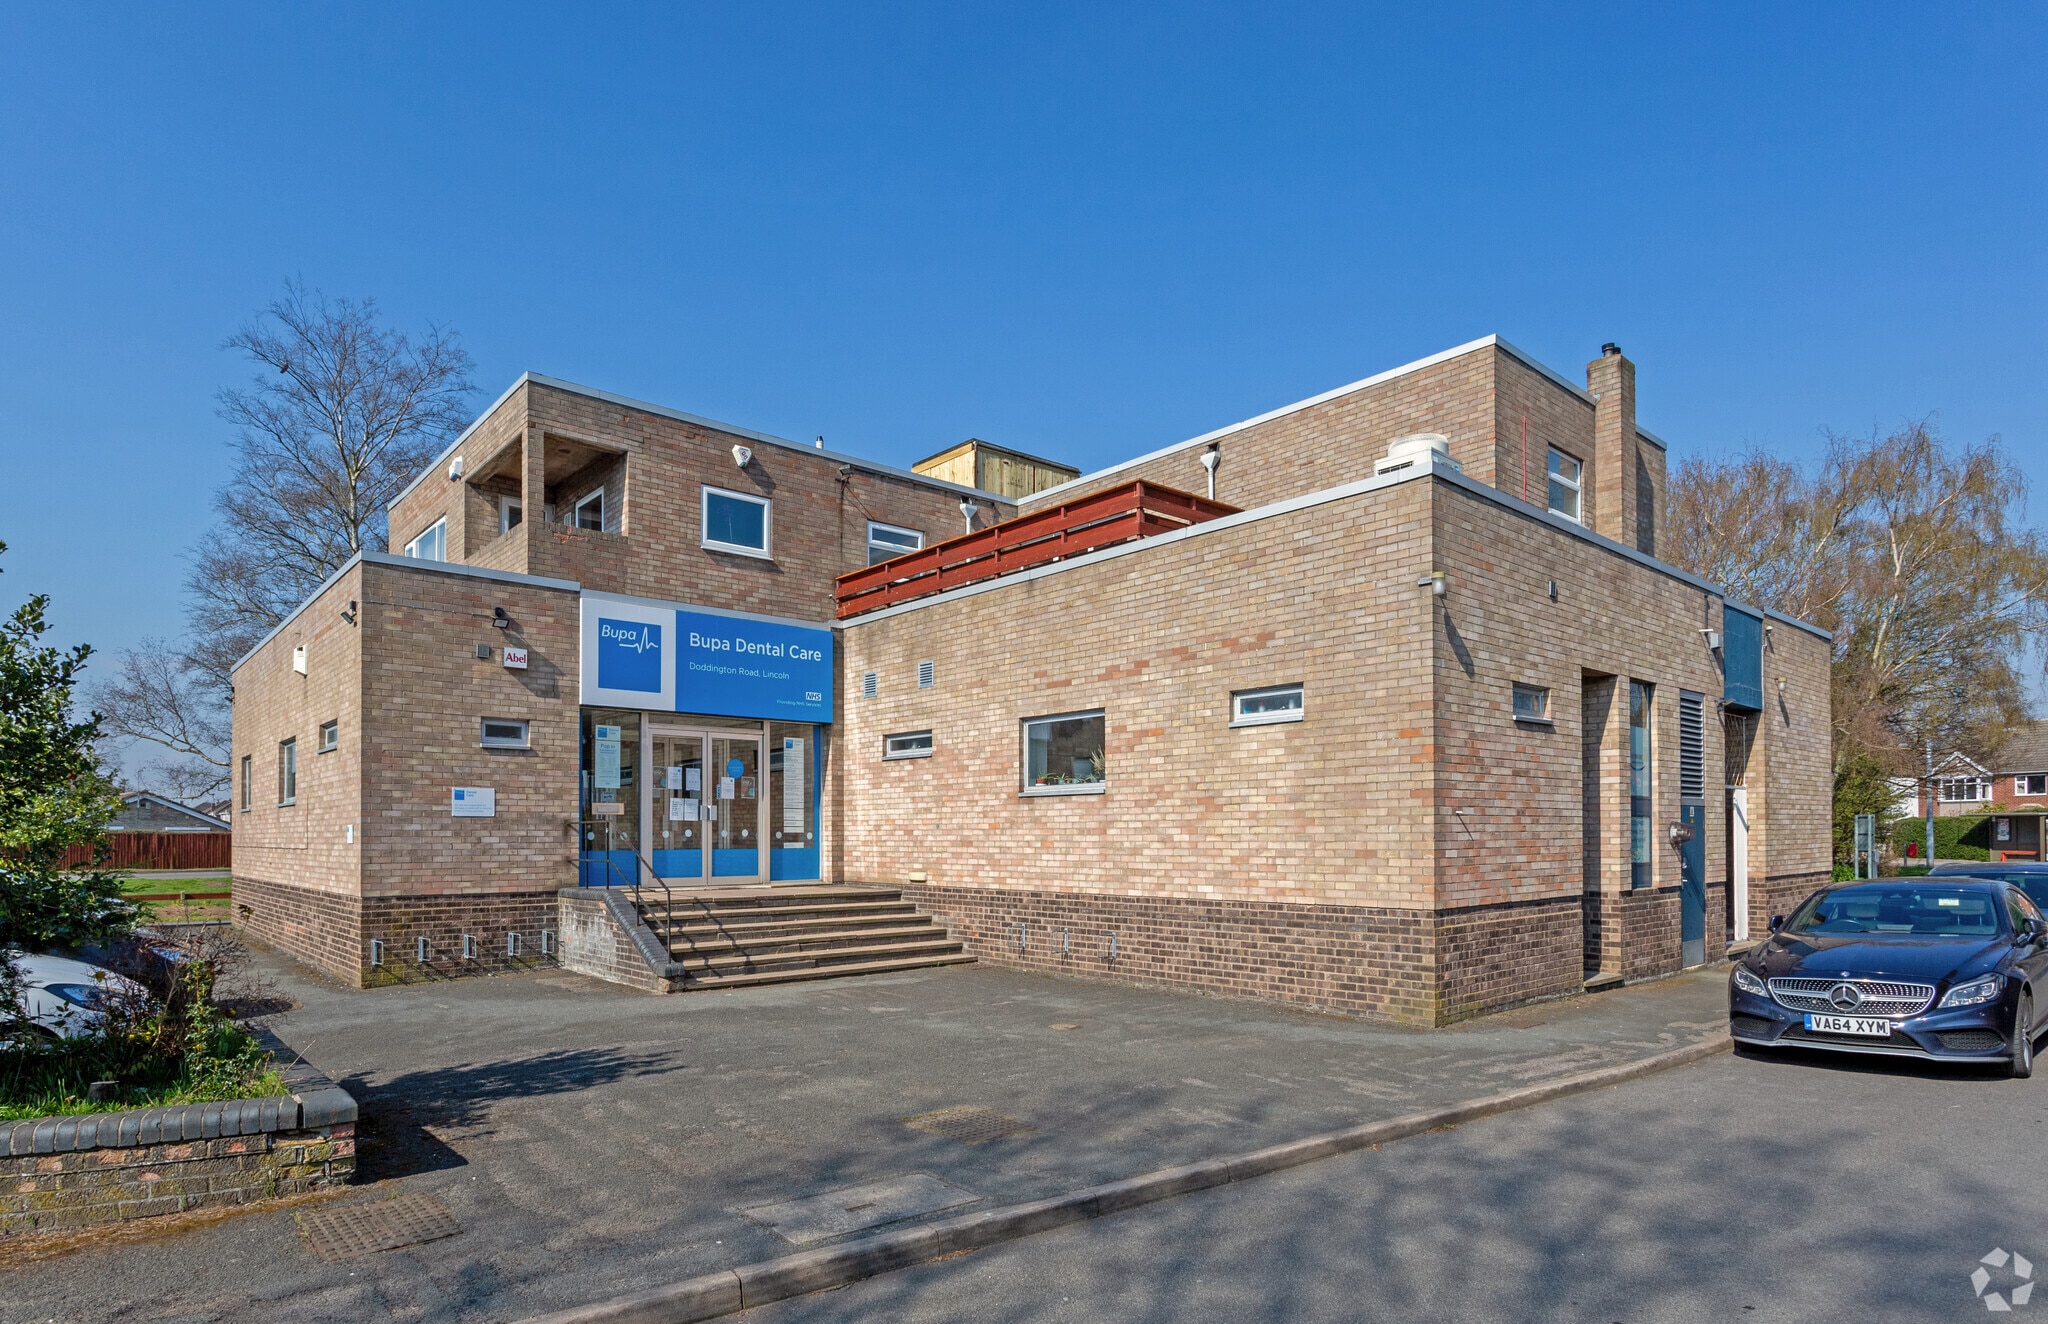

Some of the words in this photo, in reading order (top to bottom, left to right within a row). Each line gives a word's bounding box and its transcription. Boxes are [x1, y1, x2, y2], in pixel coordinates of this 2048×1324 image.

[601, 624, 637, 642] Bupa
[689, 632, 730, 653] Bupa
[735, 638, 784, 658] Dental
[789, 645, 822, 662] Care
[505, 652, 527, 664] Abel
[689, 661, 736, 676] Doddington
[739, 667, 761, 678] Road,
[763, 669, 790, 680] Lincoln
[806, 692, 821, 700] NHS
[1814, 1016, 1851, 1031] VA64
[1856, 1019, 1887, 1034] XYM
